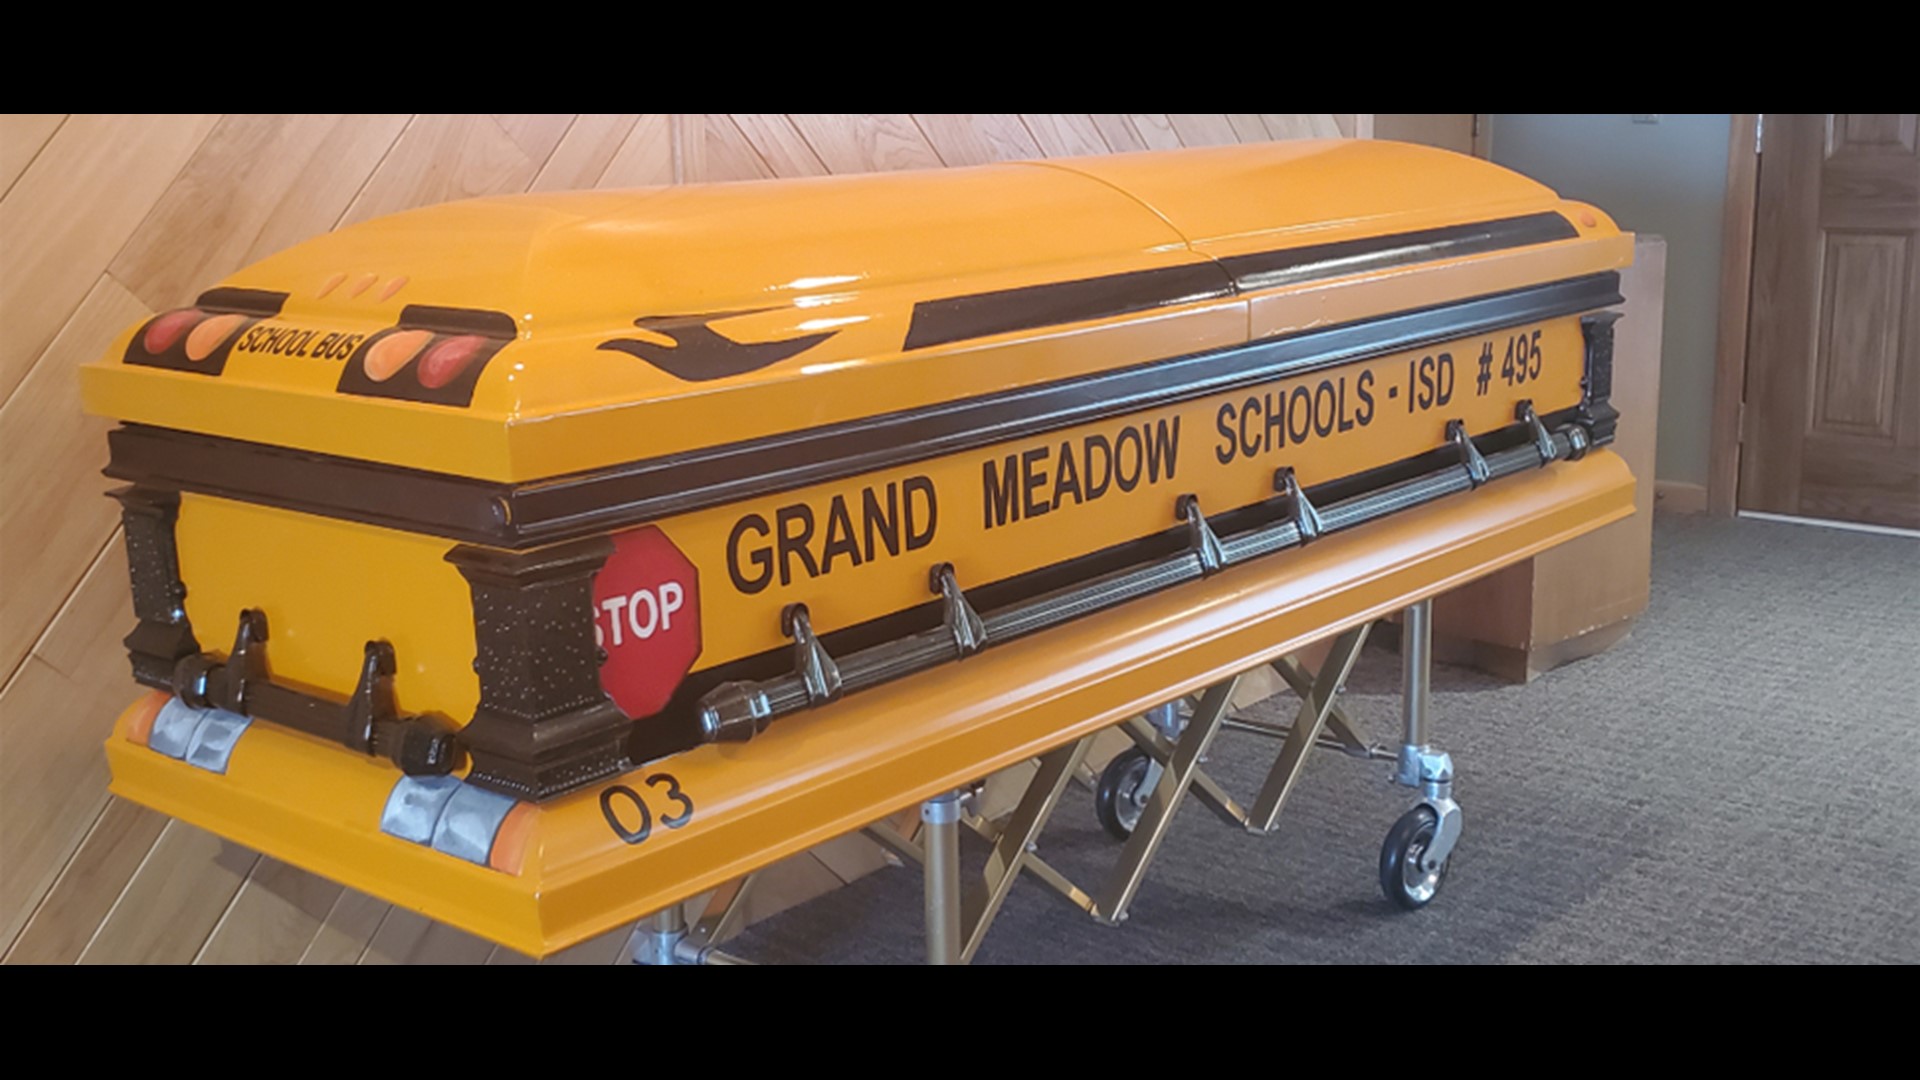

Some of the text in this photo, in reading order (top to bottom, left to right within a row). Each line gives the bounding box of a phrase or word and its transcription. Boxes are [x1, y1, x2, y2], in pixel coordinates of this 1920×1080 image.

[238, 326, 363, 361] SCHOOL BUS
[726, 475, 938, 595] GRAND
[982, 415, 1181, 530] MEADOW
[1215, 369, 1375, 464] SCHOOLS
[1408, 352, 1455, 413] ISD
[1476, 341, 1493, 396] #
[1501, 330, 1542, 387] 495
[599, 773, 694, 845] 03
